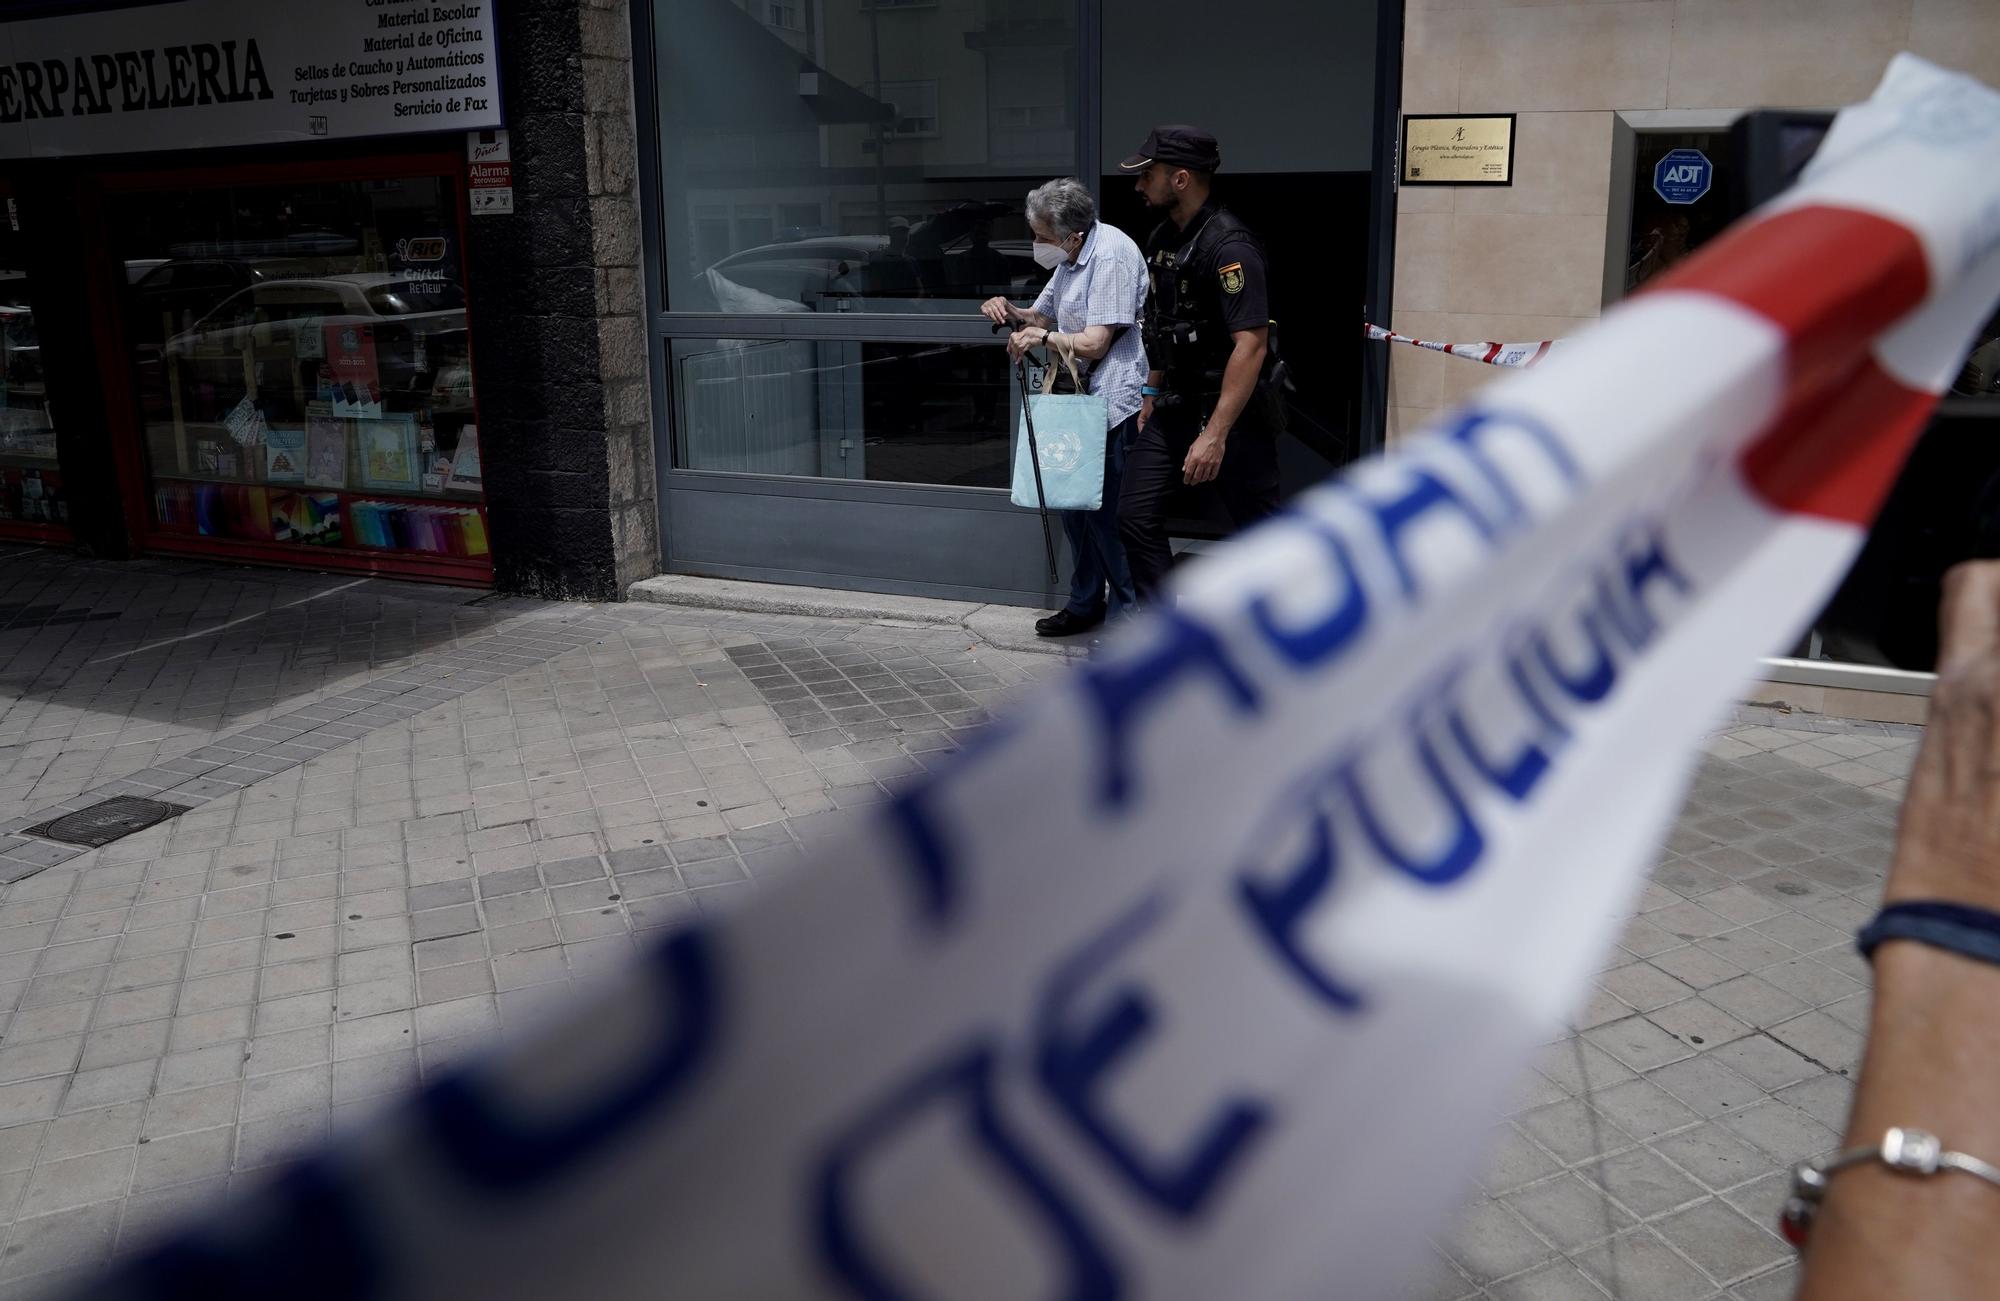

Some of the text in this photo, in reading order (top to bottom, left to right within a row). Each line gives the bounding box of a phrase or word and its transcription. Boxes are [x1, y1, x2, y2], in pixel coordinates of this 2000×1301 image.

[377, 4, 481, 28] Material Escolar
[363, 27, 483, 53] Material de Oficina
[294, 51, 485, 81] Sellos de Caucho y Automáticos
[289, 73, 486, 106] Tarjetas y Sobres Personalizados
[393, 96, 488, 118] Servicio de Fax
[470, 164, 510, 178] Alarma
[1663, 165, 1704, 184] ADT
